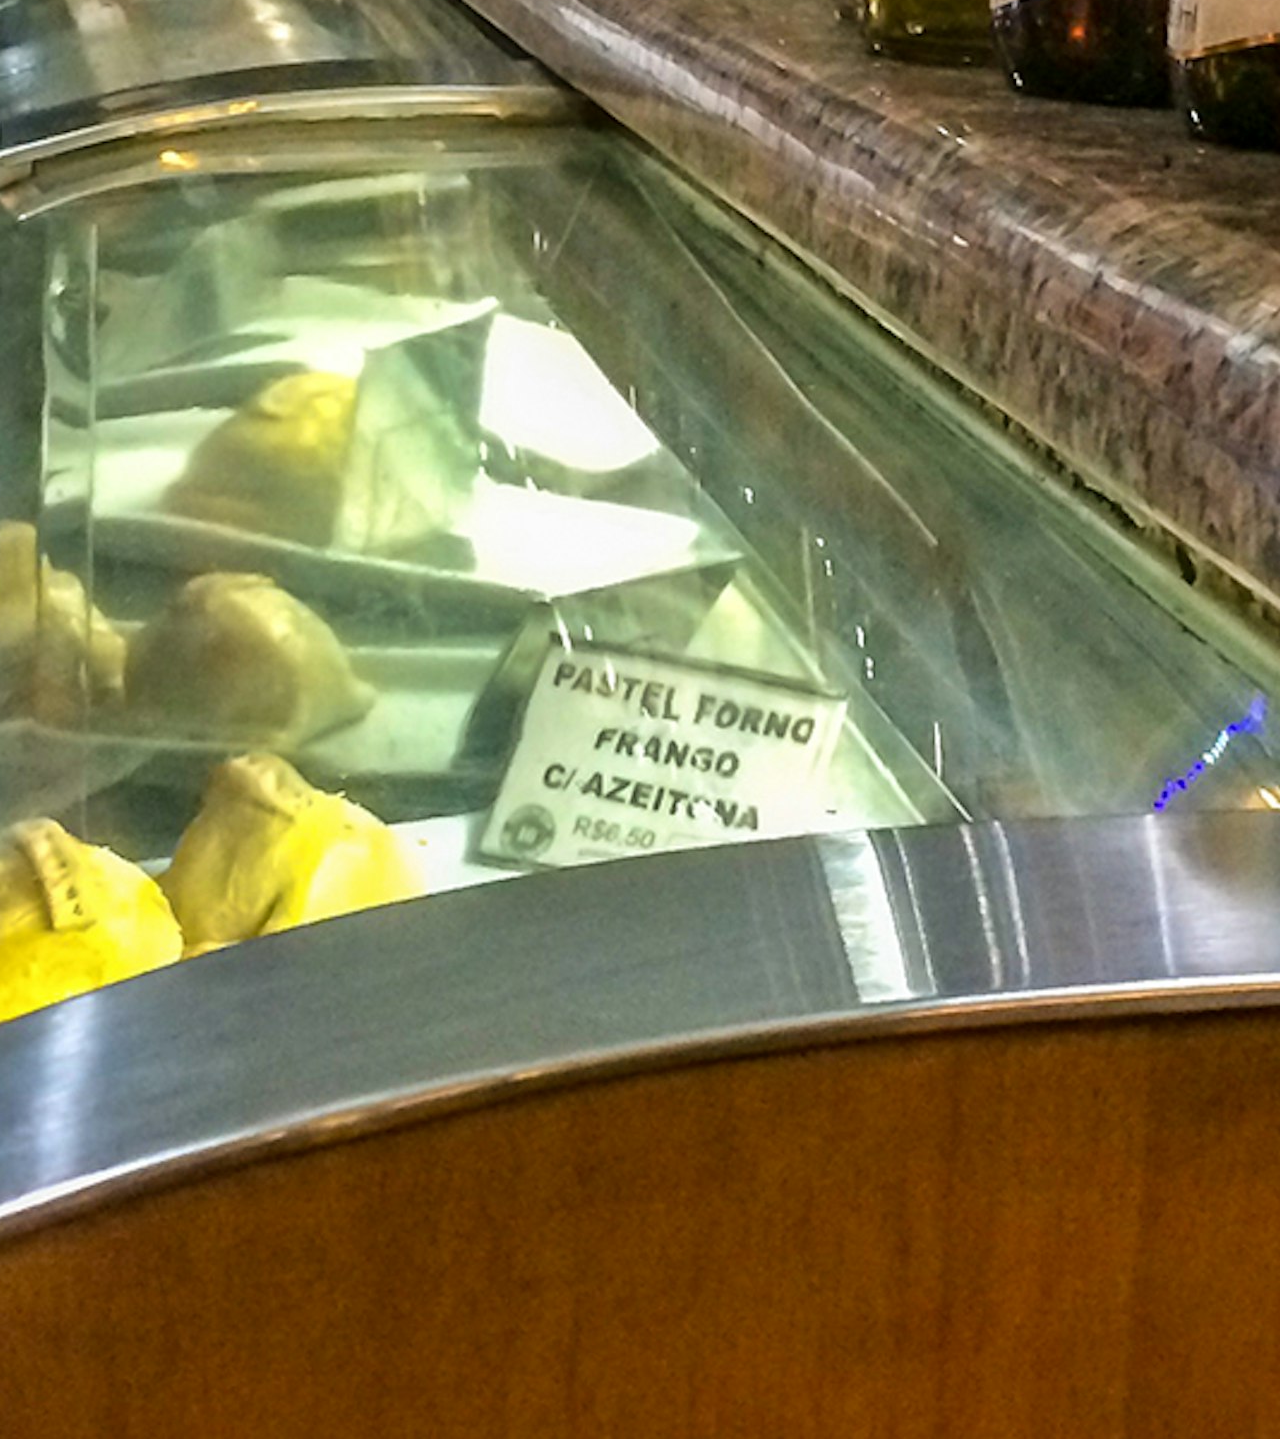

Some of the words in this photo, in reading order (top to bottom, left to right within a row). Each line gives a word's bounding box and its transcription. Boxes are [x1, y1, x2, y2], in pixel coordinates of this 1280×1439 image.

[552, 662, 681, 723] PASTEL
[692, 693, 816, 745] FORNO
[593, 727, 741, 780] FRANGO
